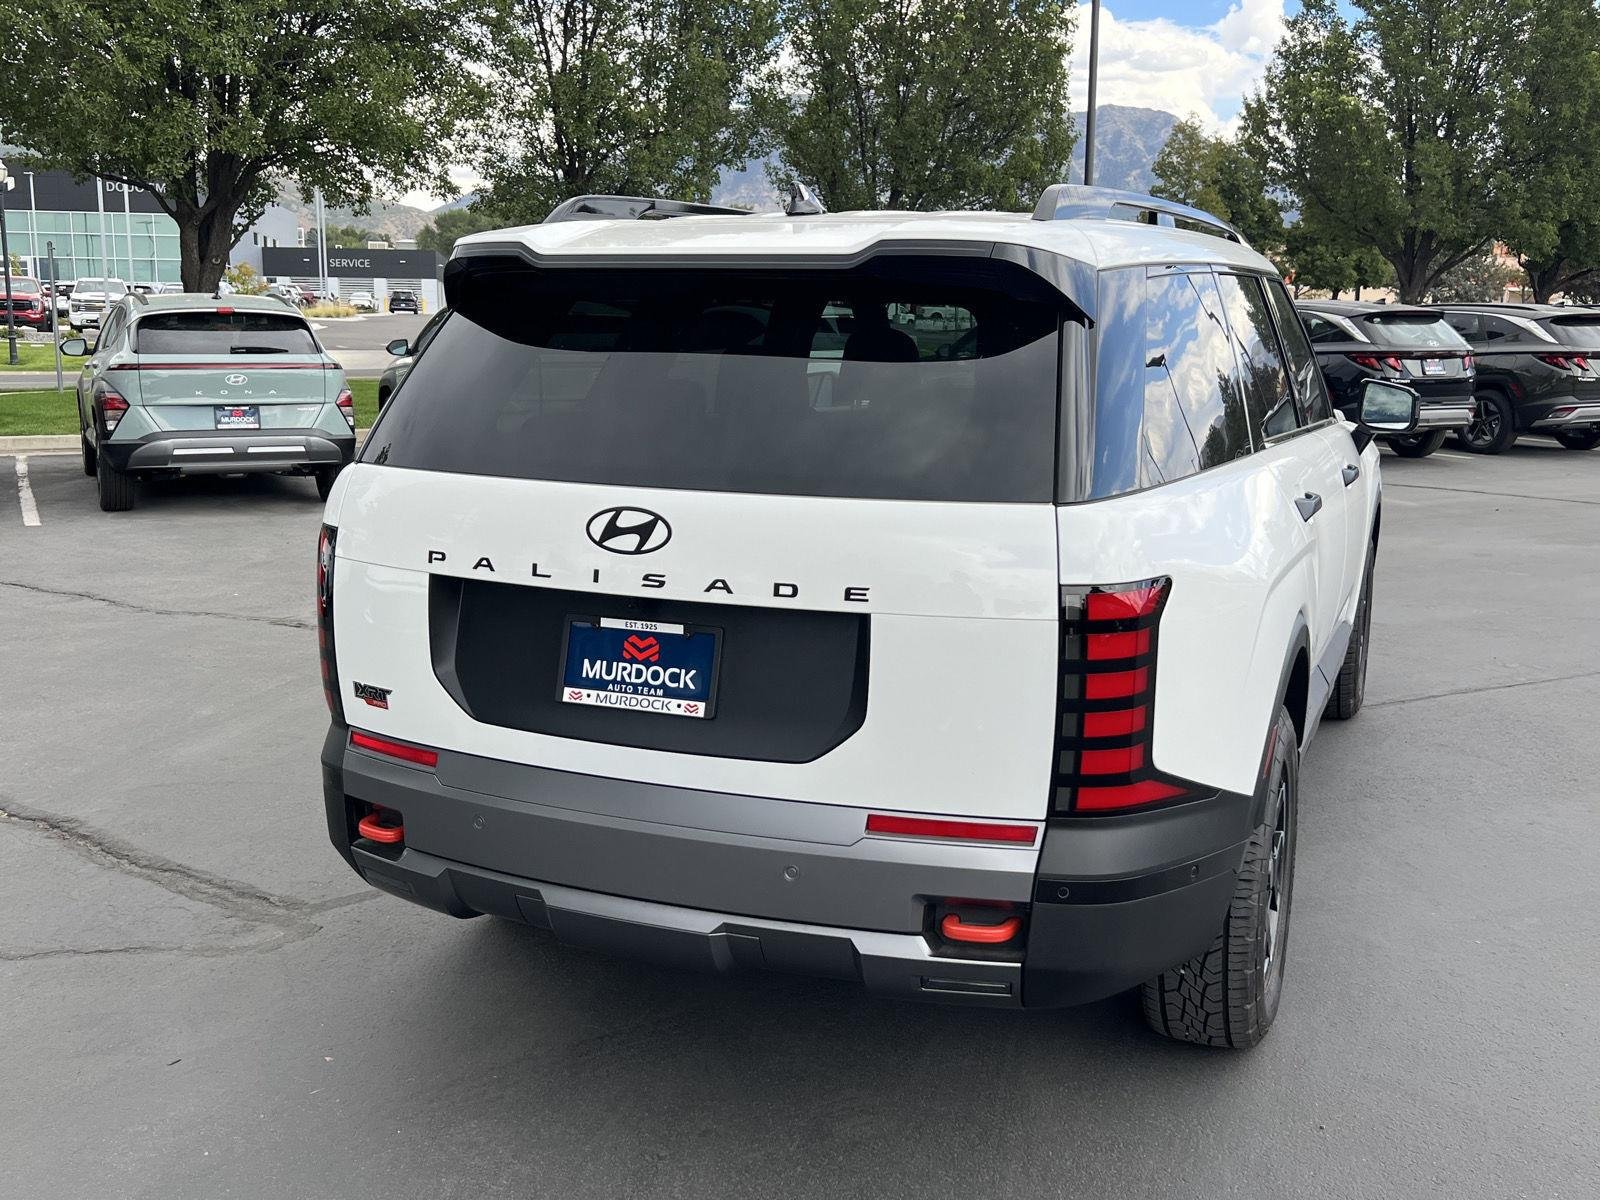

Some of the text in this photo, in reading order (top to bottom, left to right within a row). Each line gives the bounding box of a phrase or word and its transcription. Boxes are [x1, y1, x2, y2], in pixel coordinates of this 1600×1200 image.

[329, 258, 371, 268] SERVICE
[427, 550, 870, 603] PALISADE
[624, 621, 658, 631] EST. 1925
[582, 658, 697, 690] MURDOCK
[607, 683, 664, 697] AUTO TEAM
[594, 692, 672, 712] MURDOCK
